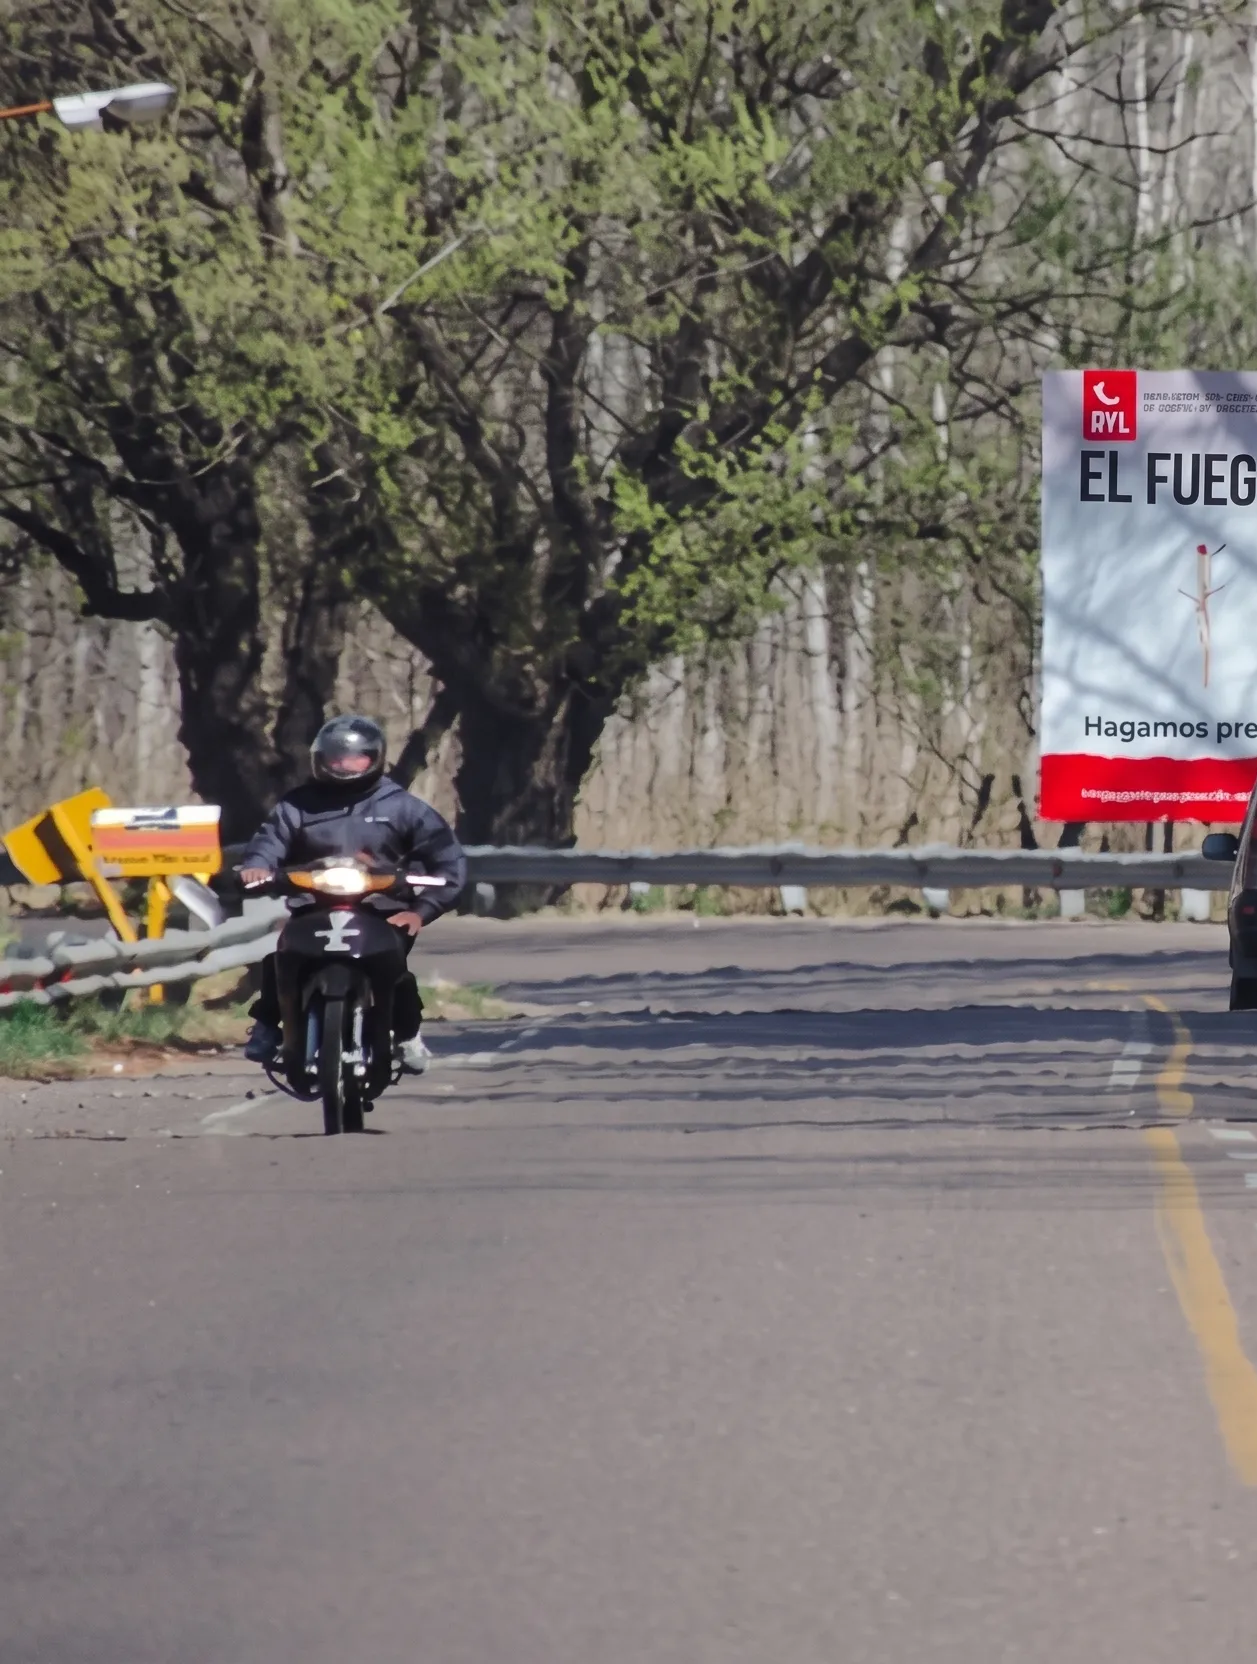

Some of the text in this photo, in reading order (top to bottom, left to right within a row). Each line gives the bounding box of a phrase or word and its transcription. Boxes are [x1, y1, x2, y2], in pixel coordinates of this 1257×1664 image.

[1091, 410, 1130, 433] RYL
[1080, 450, 1132, 502] EL
[1085, 716, 1208, 742] Hagamos
